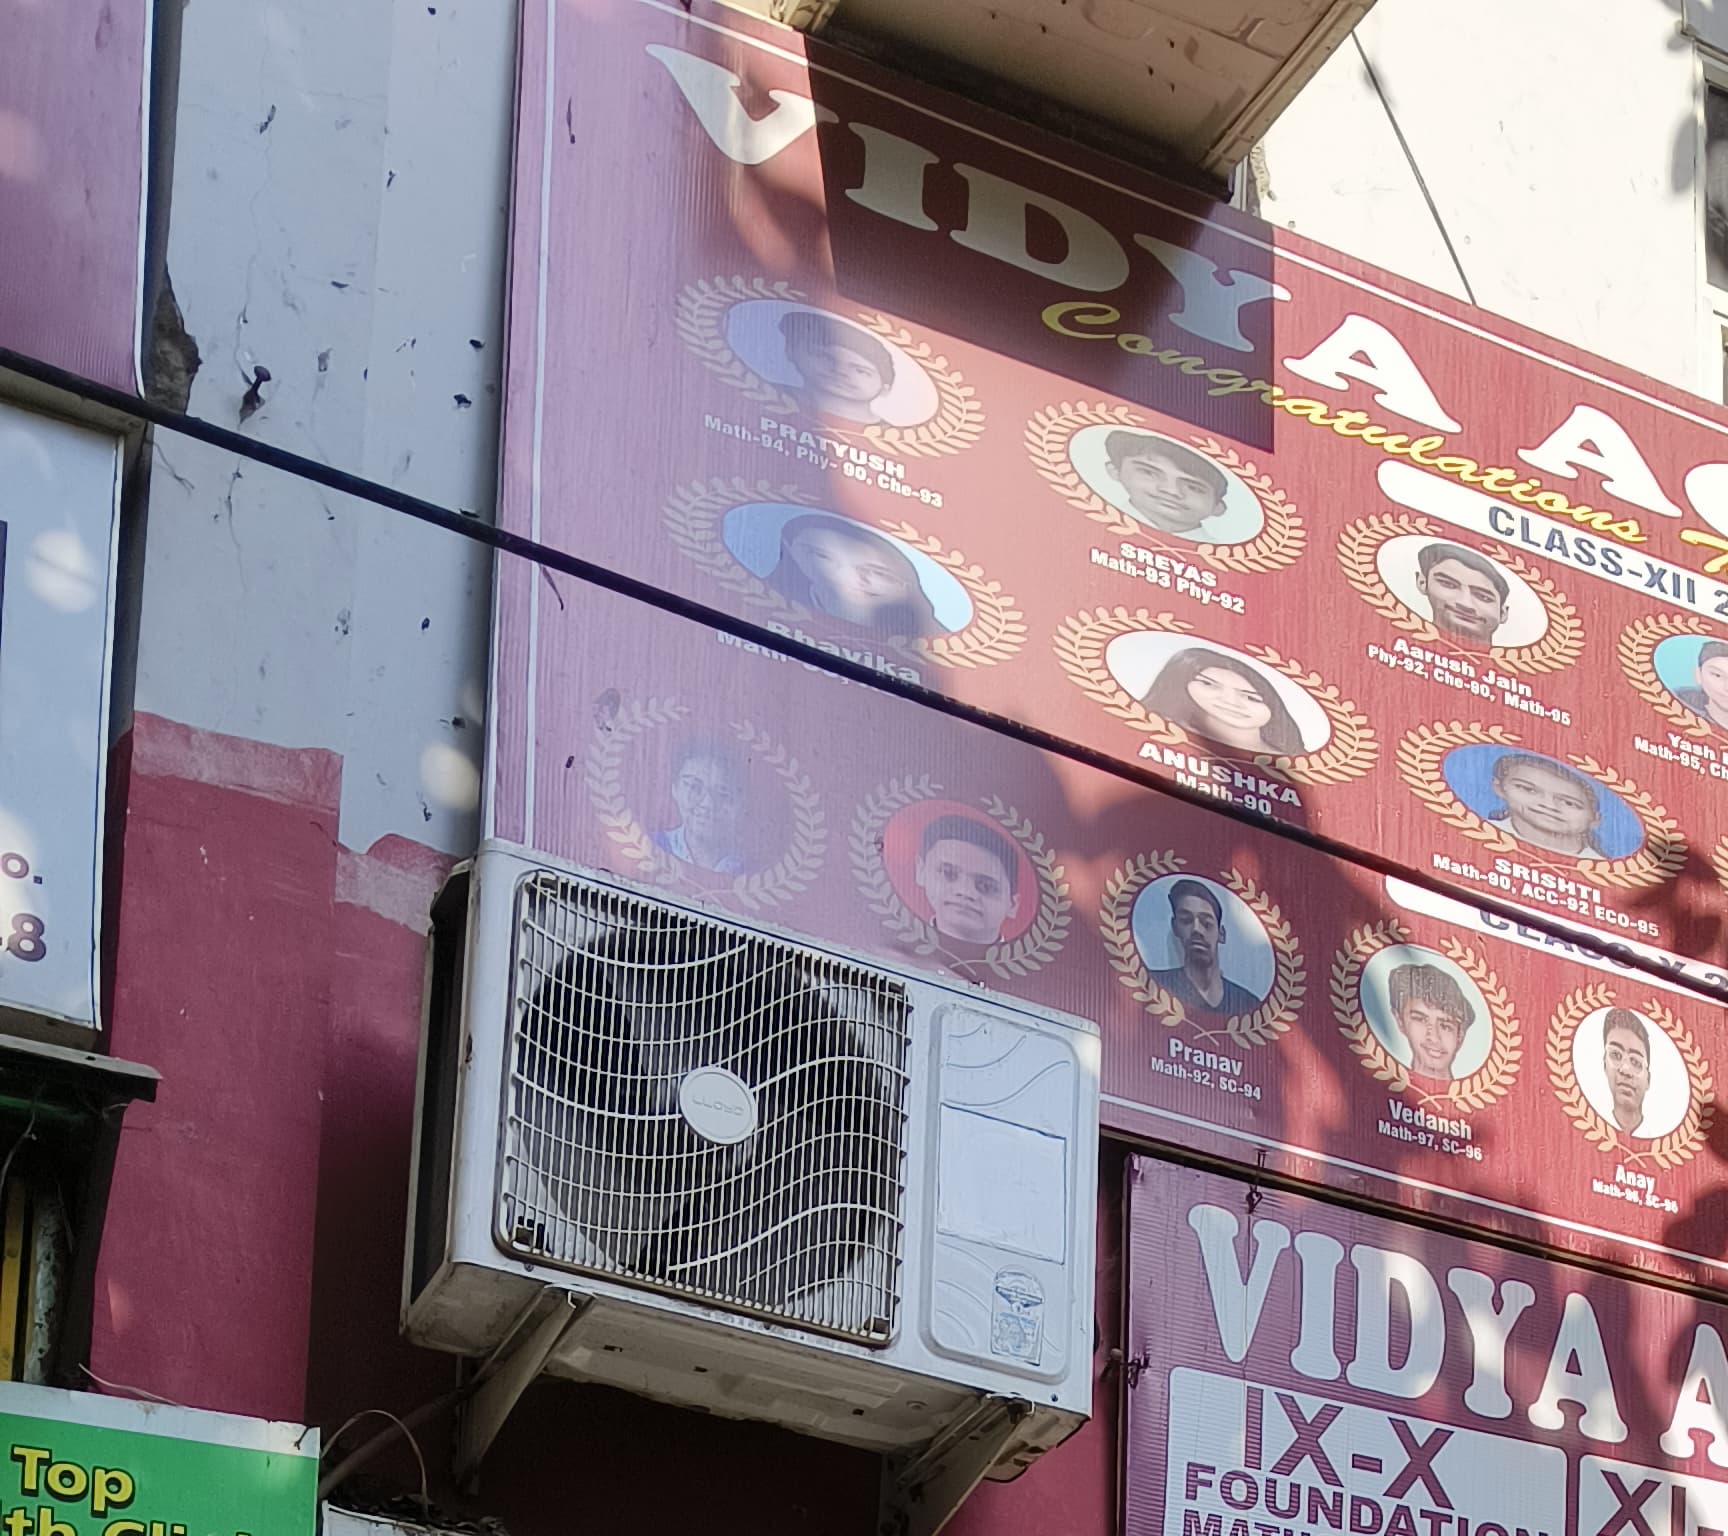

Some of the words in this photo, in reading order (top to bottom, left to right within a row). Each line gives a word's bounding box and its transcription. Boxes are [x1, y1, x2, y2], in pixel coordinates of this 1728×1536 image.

[645, 43, 1462, 434] VIDYA
[760, 418, 905, 479] PRATYUSH
[1041, 301, 1647, 542] Congratulations
[1091, 548, 1171, 588] Math-93
[1176, 577, 1245, 614] Phy-92
[1120, 543, 1217, 587] SREYAS
[1488, 505, 1697, 606] CLASS-XII
[1393, 638, 1476, 678] Aarush
[1482, 669, 1532, 698] Jain
[1139, 742, 1302, 807] ANUSHKA
[1668, 732, 1715, 761] Yash
[1176, 771, 1271, 815] Math-90
[1433, 854, 1517, 893] Math-90,
[1521, 882, 1589, 916] ACC-92
[1594, 904, 1659, 937] ECO-95
[1495, 858, 1601, 904] SRISHTI
[1169, 1038, 1242, 1076] Pranav
[1389, 1099, 1472, 1140] Vedansh
[1615, 1164, 1655, 1196] Anay
[1188, 1203, 1629, 1443] VIDYA
[1243, 1385, 1455, 1510] IX-X
[11, 1444, 135, 1518] Top
